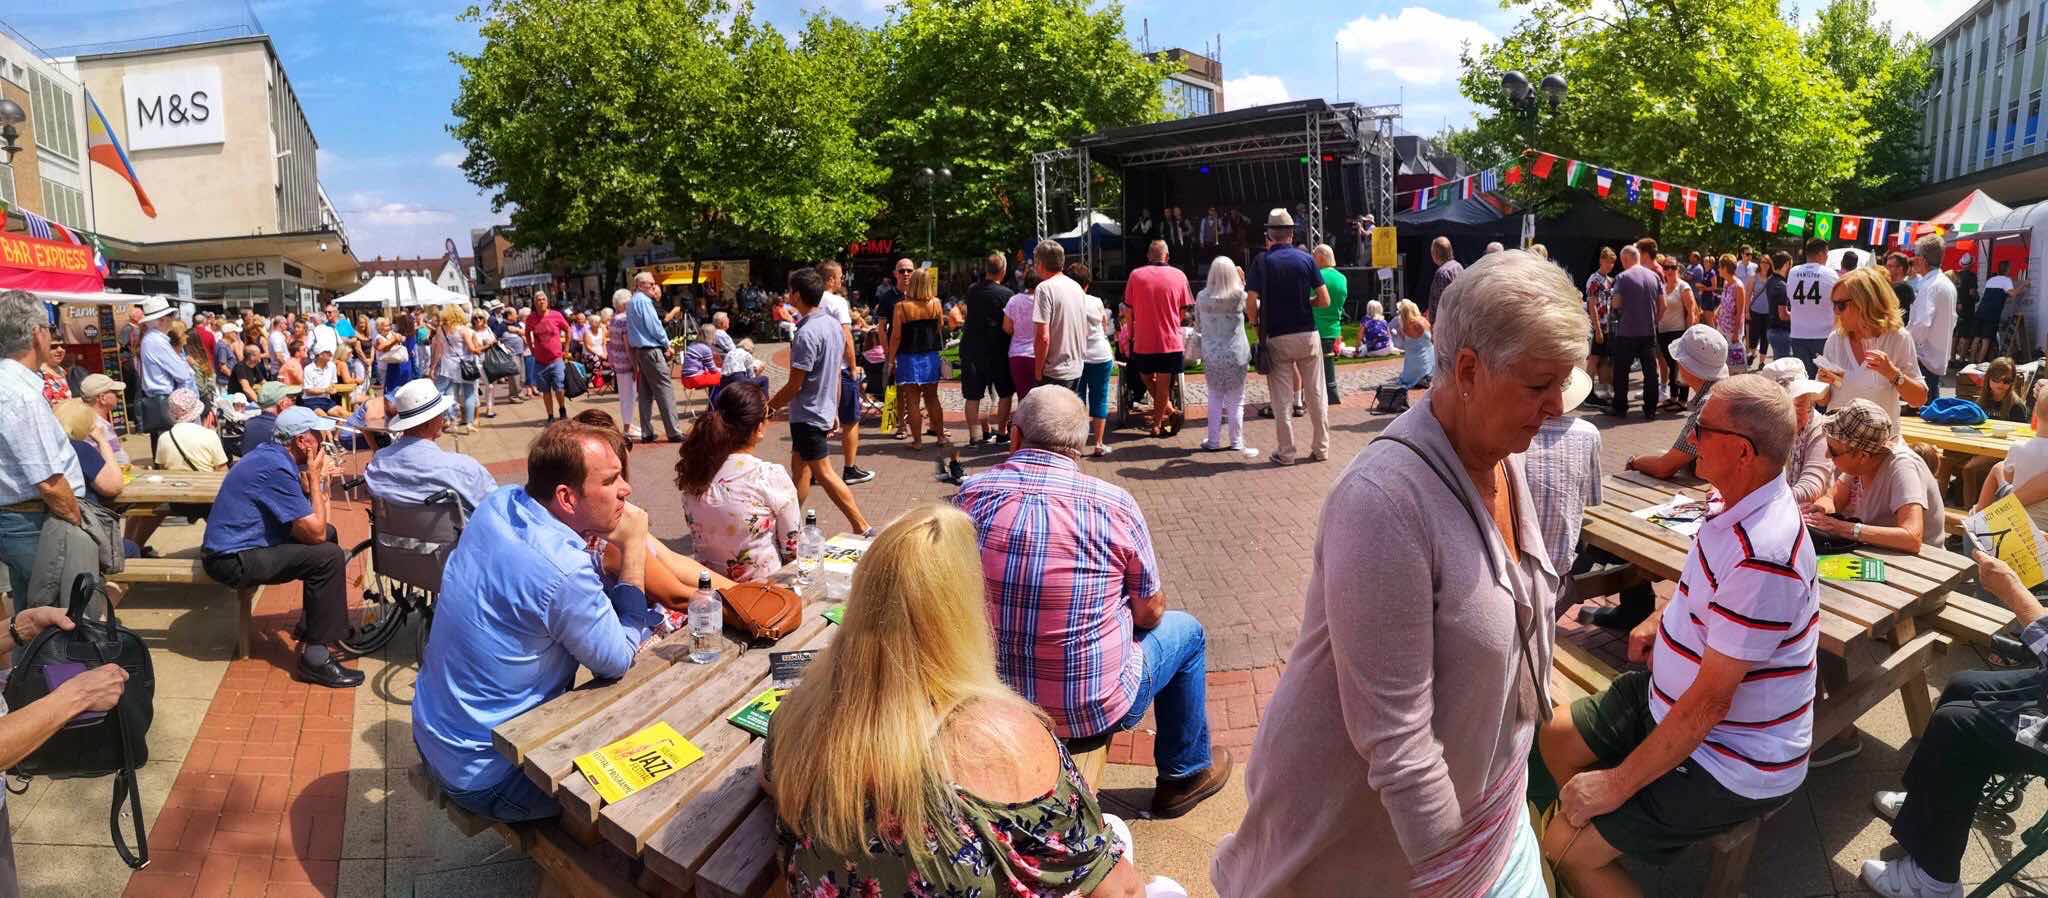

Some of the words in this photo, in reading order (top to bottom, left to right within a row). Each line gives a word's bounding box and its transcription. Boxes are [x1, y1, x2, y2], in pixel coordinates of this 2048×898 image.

[137, 91, 209, 128] M&S
[1, 237, 33, 264] BAR
[35, 243, 88, 271] EXPRESS
[194, 262, 266, 279] SPENCER
[1793, 280, 1822, 305] 44
[629, 751, 672, 777] JAZZ
